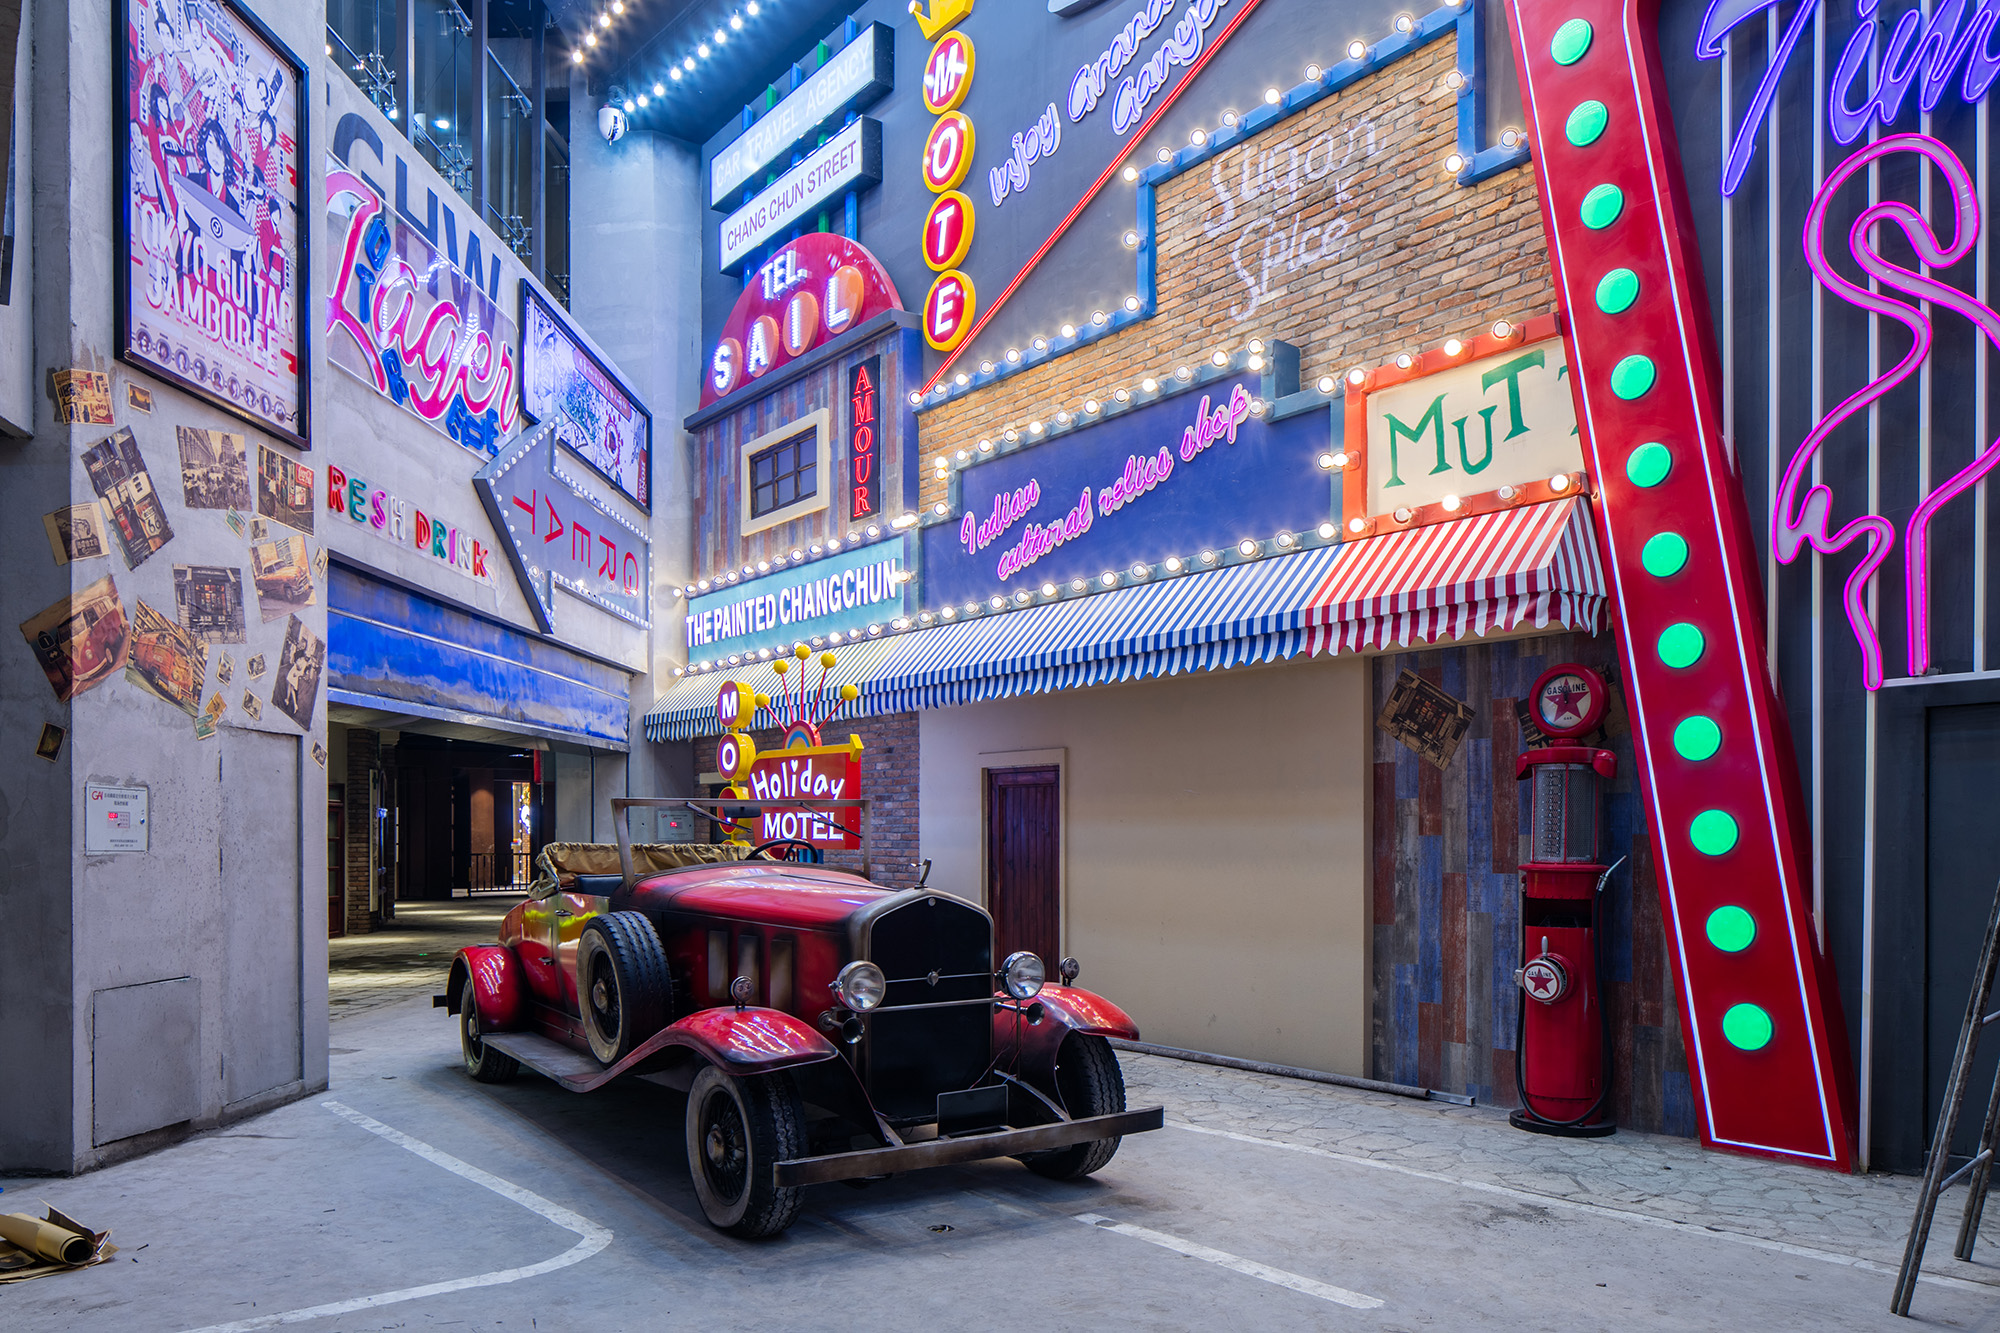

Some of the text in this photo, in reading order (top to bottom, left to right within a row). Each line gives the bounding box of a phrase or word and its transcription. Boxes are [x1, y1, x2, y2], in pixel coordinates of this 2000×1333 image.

[716, 41, 870, 188] CAR TRAVEL AGENCY
[1696, 0, 2000, 197] Tim
[727, 140, 857, 251] CHANG CHUN STREET
[145, 257, 280, 376] JAMBOREE
[214, 250, 295, 335] GUITAR
[326, 168, 518, 434] Lager
[714, 275, 850, 390] SAIL
[852, 365, 875, 518] AMOUR
[1383, 348, 1579, 489] MUT
[996, 383, 1252, 581] cultural relics shop
[415, 508, 489, 579] DRINK
[685, 557, 898, 648] THE PAINTED CHANGCHUN
[1546, 683, 1587, 695] GASOLINE
[750, 758, 845, 801] Holiday
[763, 811, 844, 841] MOTEL
